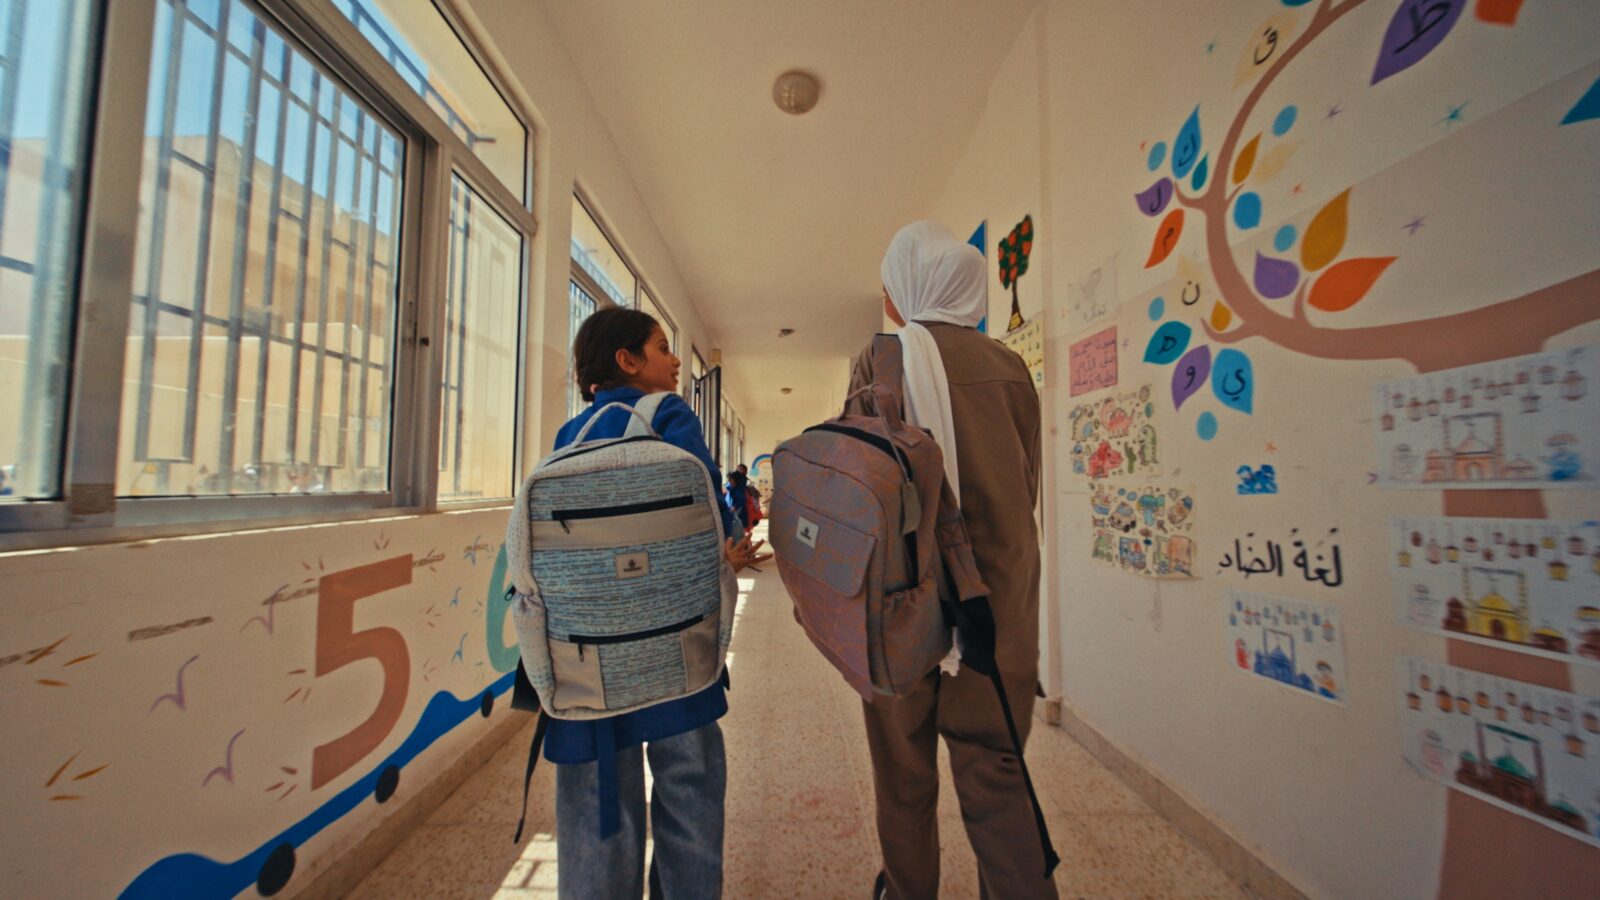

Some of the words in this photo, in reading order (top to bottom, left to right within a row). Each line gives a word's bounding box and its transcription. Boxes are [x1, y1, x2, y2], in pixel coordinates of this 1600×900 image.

[1253, 26, 1278, 66] ق
[1178, 133, 1197, 168] ك
[1150, 186, 1162, 213] ل
[1162, 226, 1175, 254] م
[1181, 280, 1200, 306] ن
[1183, 365, 1196, 391] و
[1221, 368, 1246, 401] ي
[311, 553, 413, 791] 5
